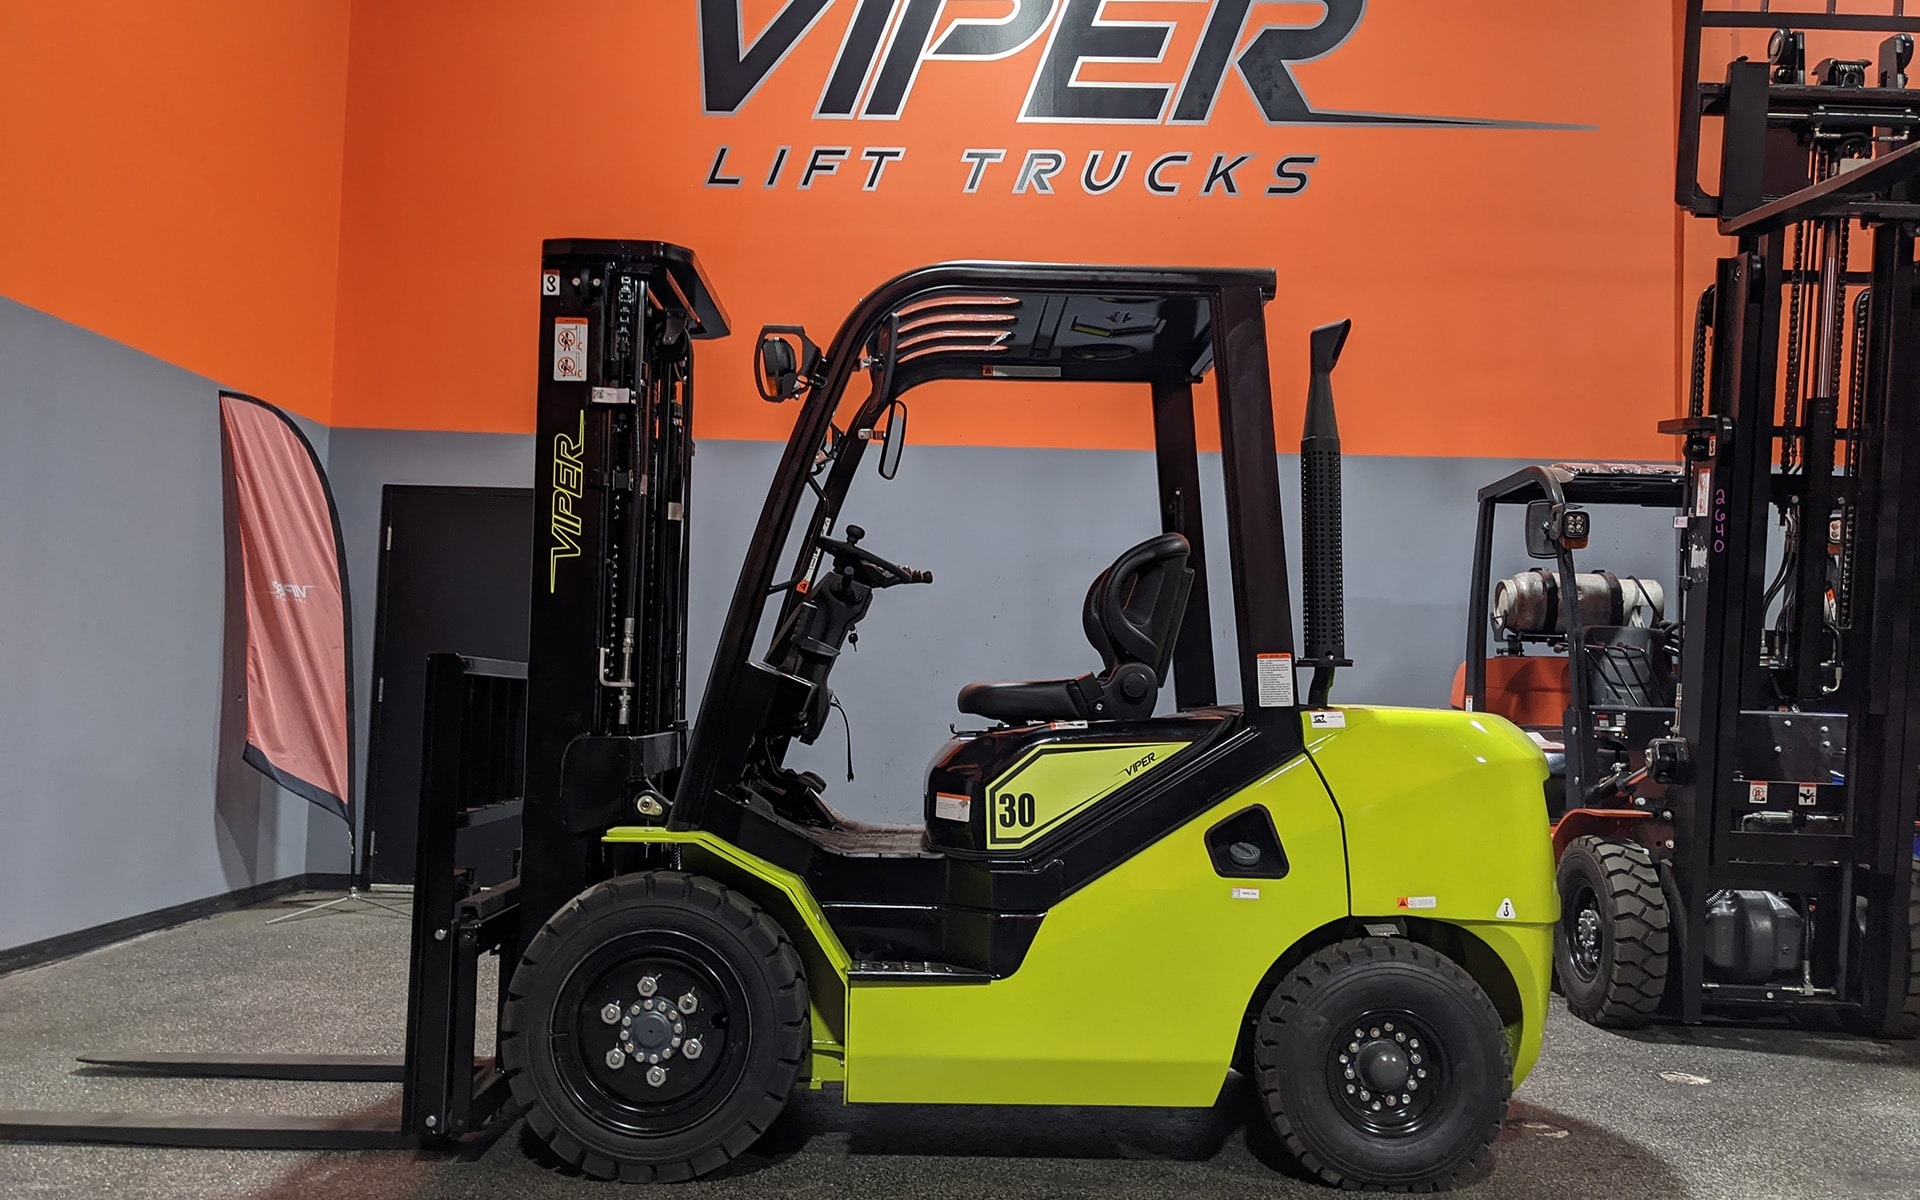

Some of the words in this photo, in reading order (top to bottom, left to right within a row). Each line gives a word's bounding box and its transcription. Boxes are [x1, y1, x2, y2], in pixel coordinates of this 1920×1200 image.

[697, 0, 1596, 132] VIPER
[704, 146, 906, 192] LIFT
[960, 148, 1319, 196] TRUCKS
[551, 410, 584, 592] VIPER
[1714, 489, 1726, 553] 2640
[1117, 752, 1163, 776] VIPER
[999, 793, 1036, 828] 30
